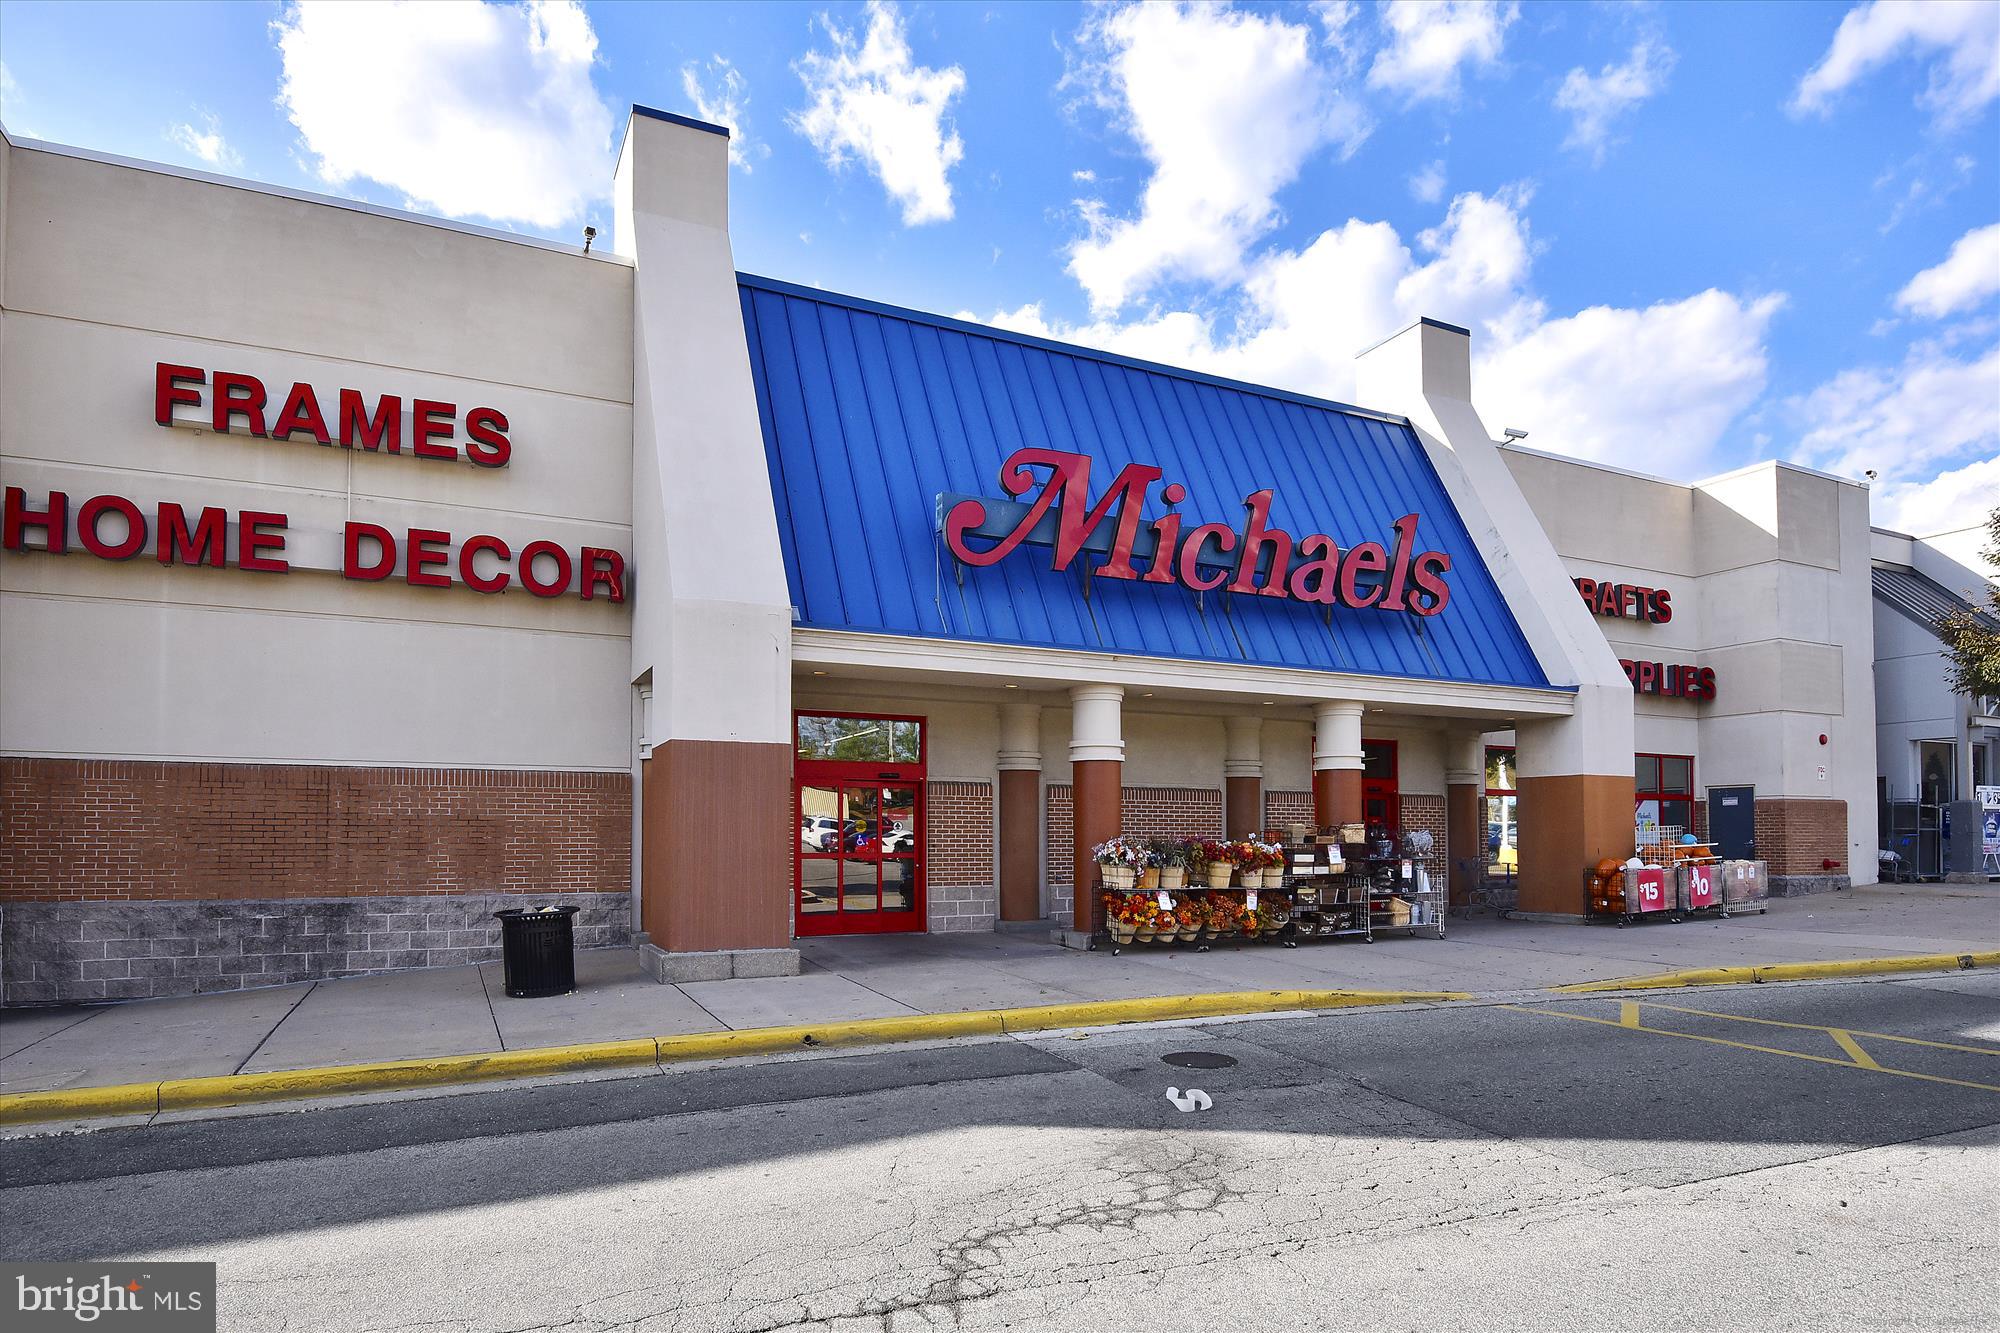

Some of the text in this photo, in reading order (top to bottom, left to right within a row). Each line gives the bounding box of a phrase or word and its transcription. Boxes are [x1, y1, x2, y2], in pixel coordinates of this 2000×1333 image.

[155, 361, 512, 468] FRAMES
[3, 486, 625, 603] HOME DECOR
[942, 447, 1451, 617] Michaels
[1570, 576, 1672, 624] RAFTS
[1639, 882, 1659, 901] $15
[1691, 878, 1709, 896] $10
